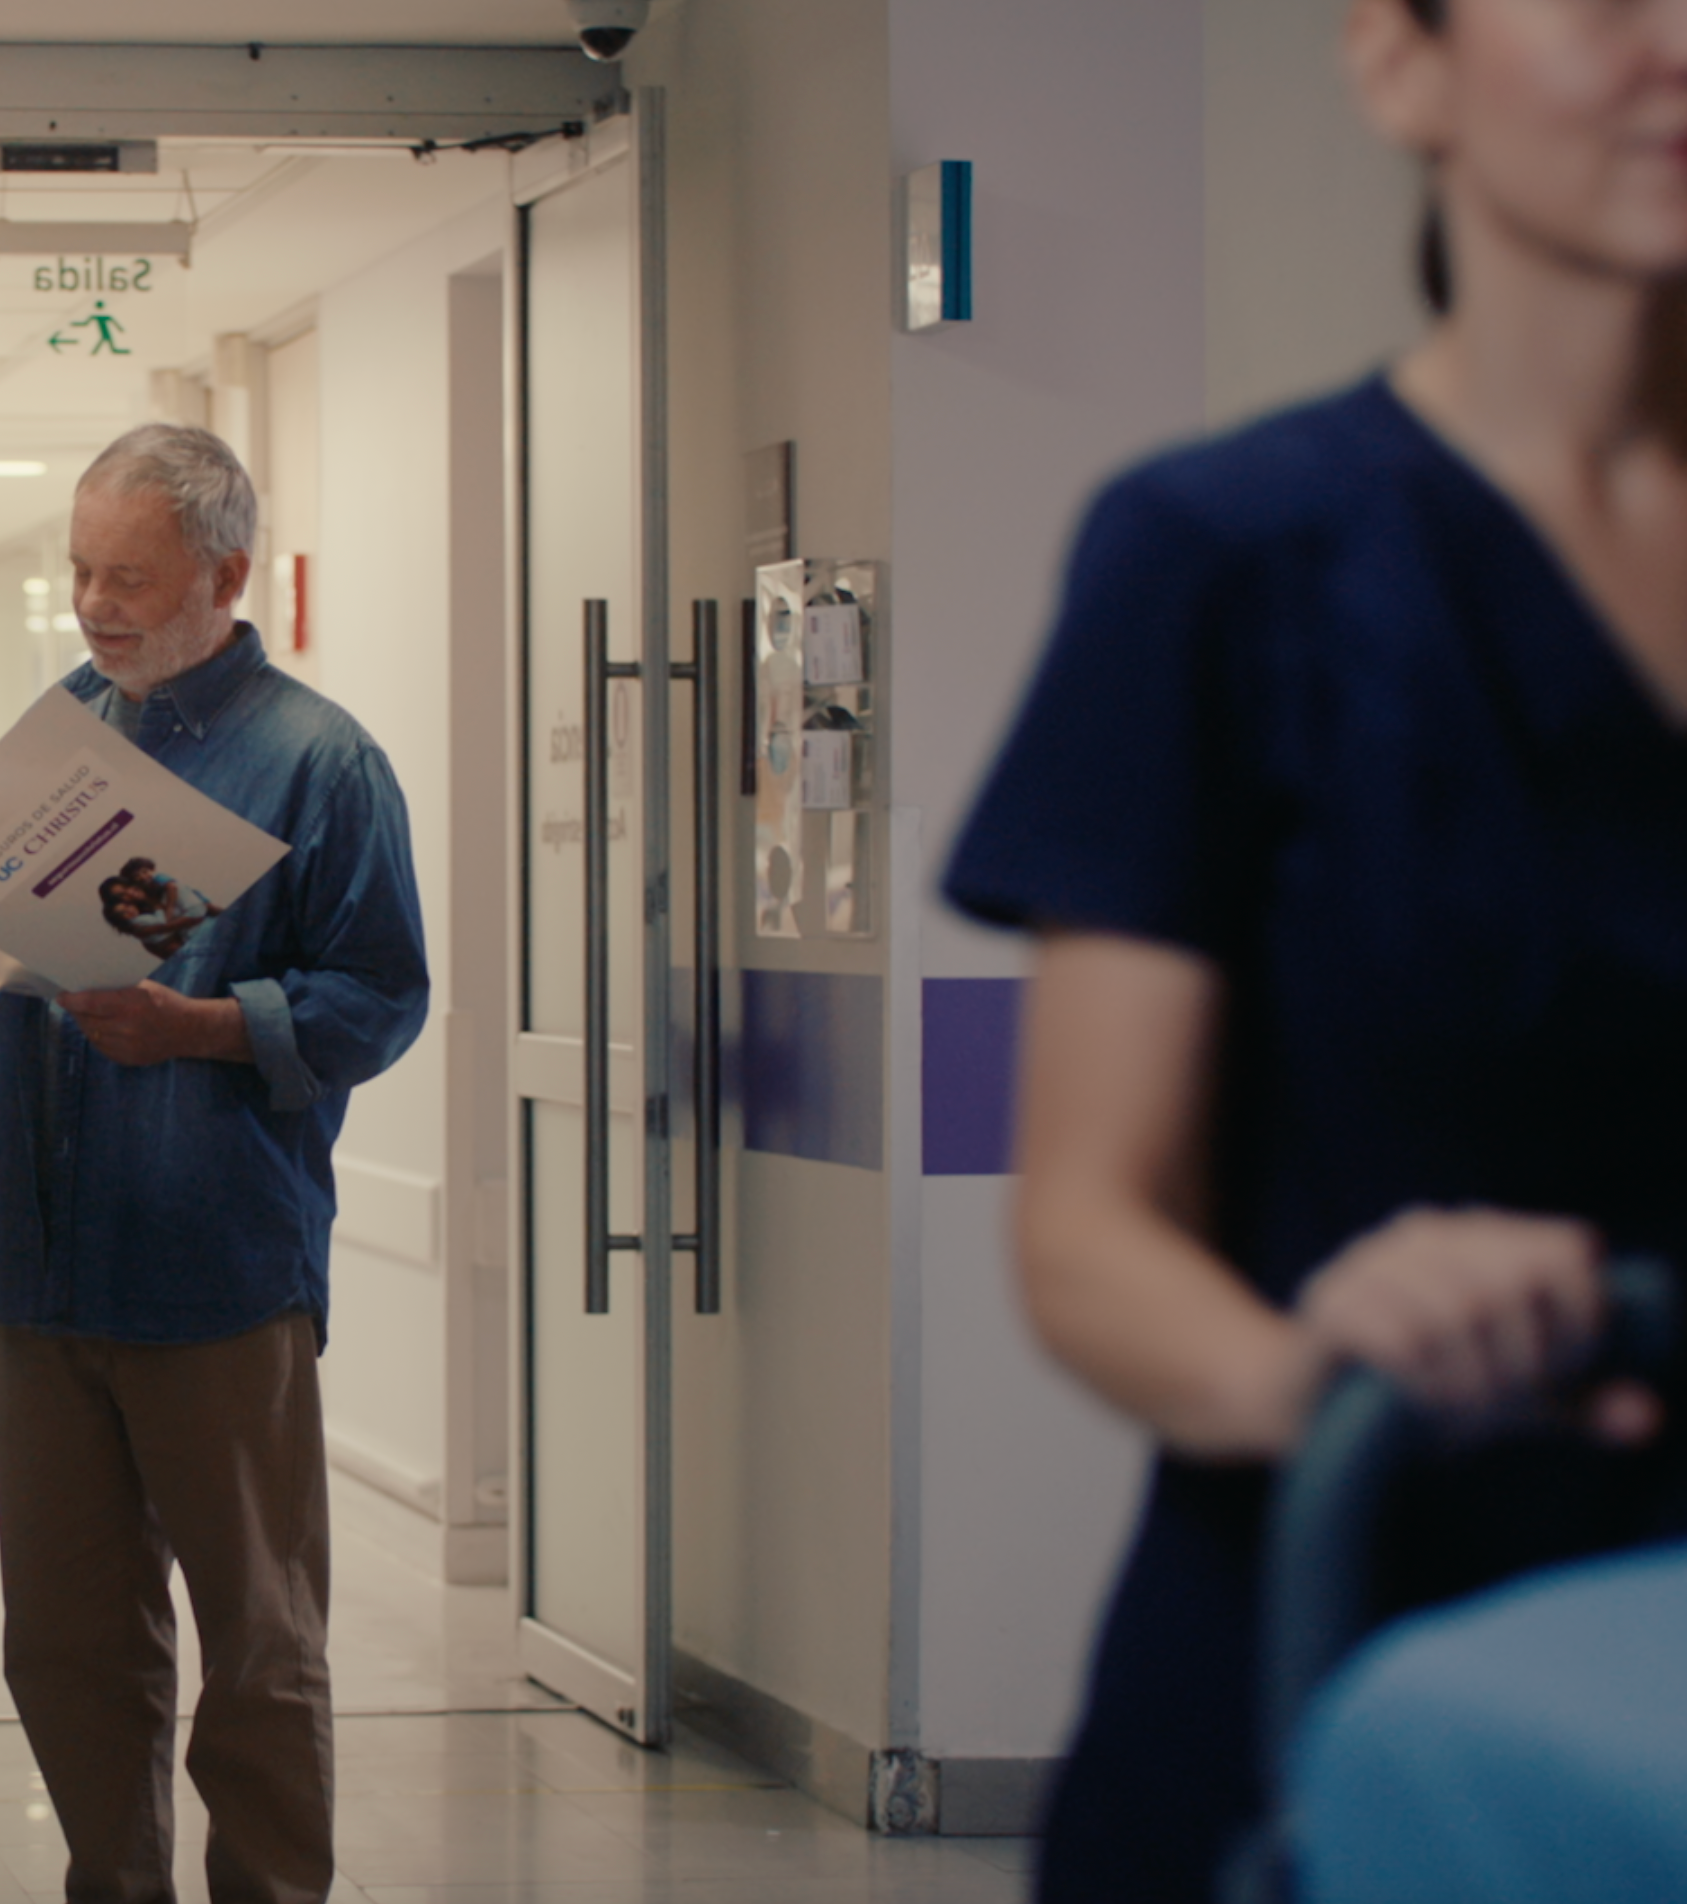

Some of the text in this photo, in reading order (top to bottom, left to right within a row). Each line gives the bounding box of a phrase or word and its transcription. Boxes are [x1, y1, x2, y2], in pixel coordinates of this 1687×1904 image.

[23, 776, 110, 855] CHRISTUS
[31, 803, 52, 821] DE
[49, 765, 90, 803] SALUD
